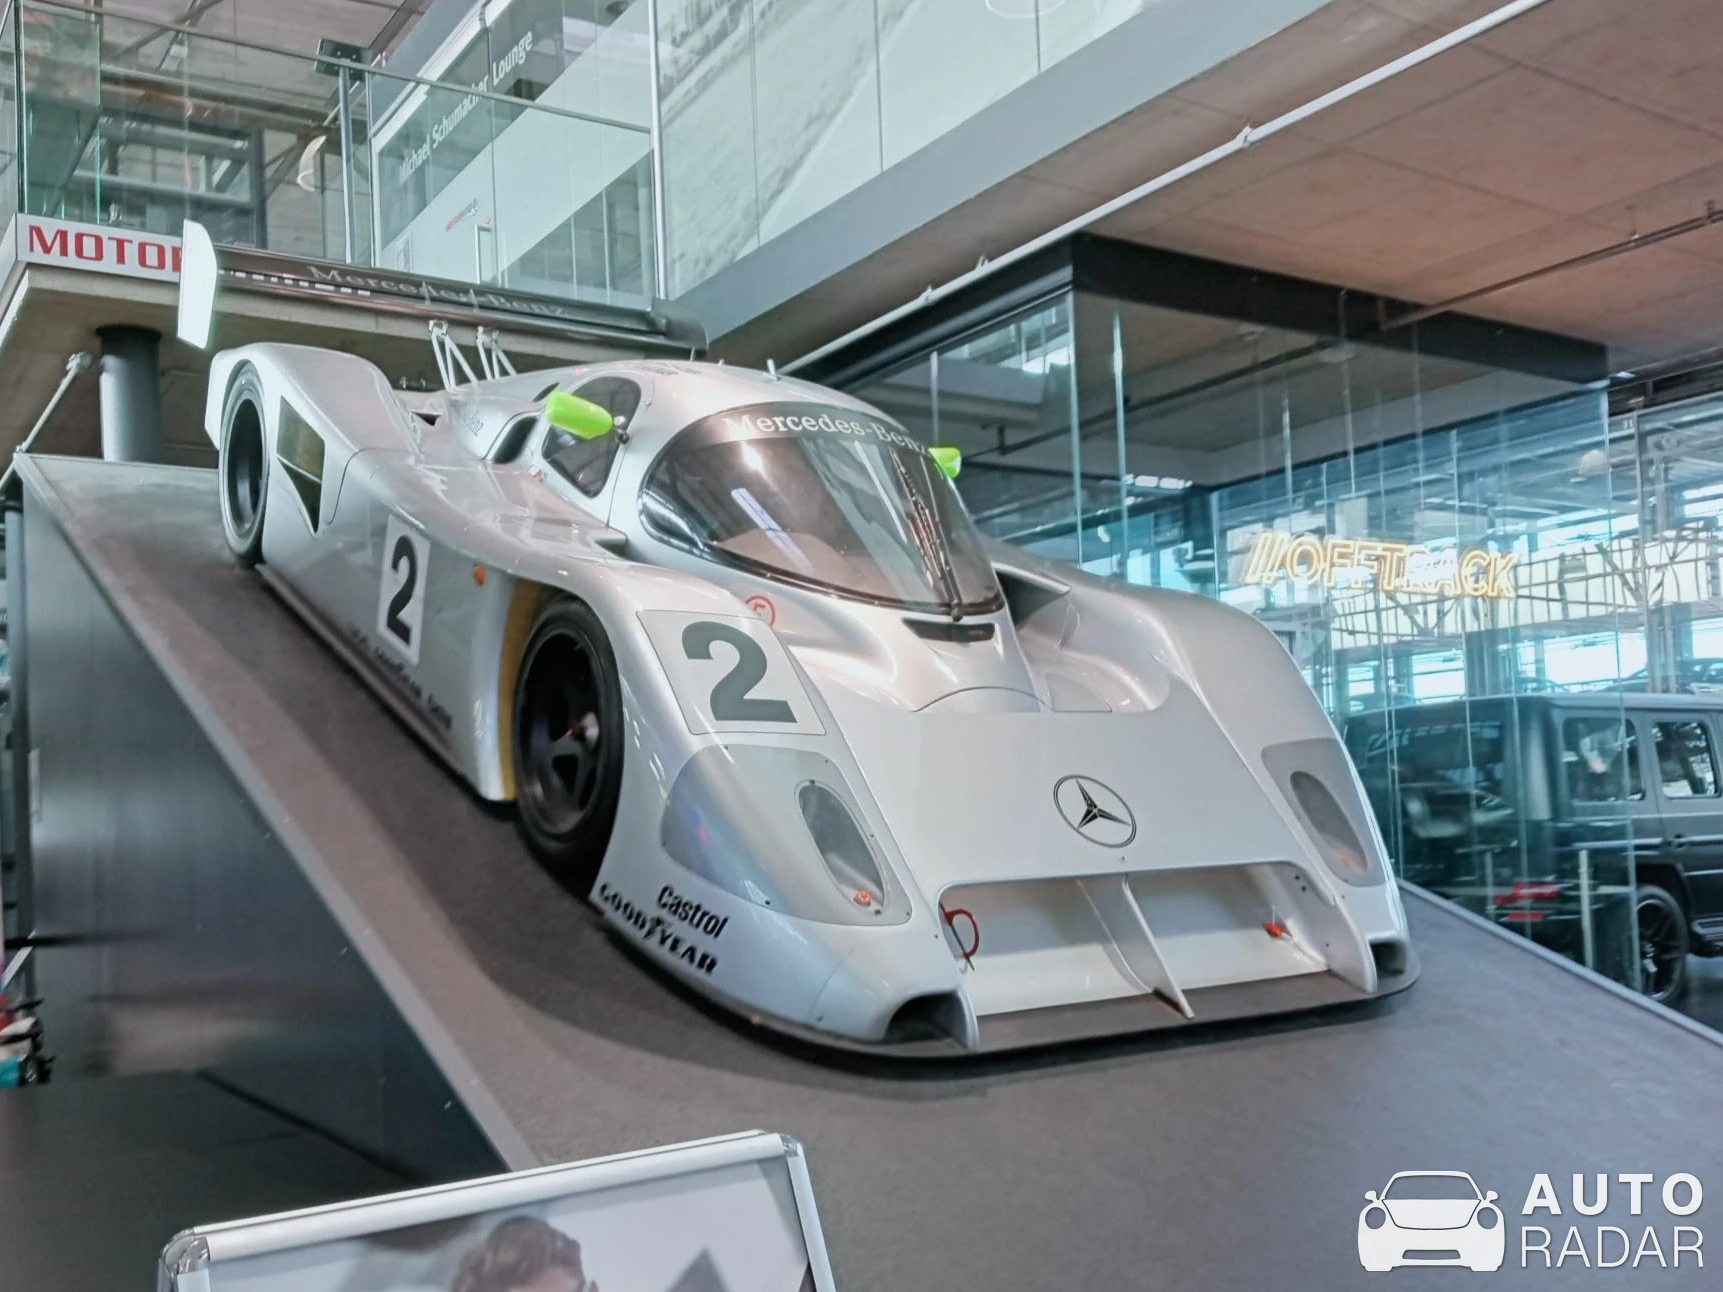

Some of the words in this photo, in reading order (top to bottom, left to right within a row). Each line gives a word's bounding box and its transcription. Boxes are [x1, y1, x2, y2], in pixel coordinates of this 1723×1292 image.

[492, 31, 533, 86] Lounge
[387, 535, 417, 646] 2
[682, 621, 798, 723] 2
[657, 885, 730, 938] Castrol
